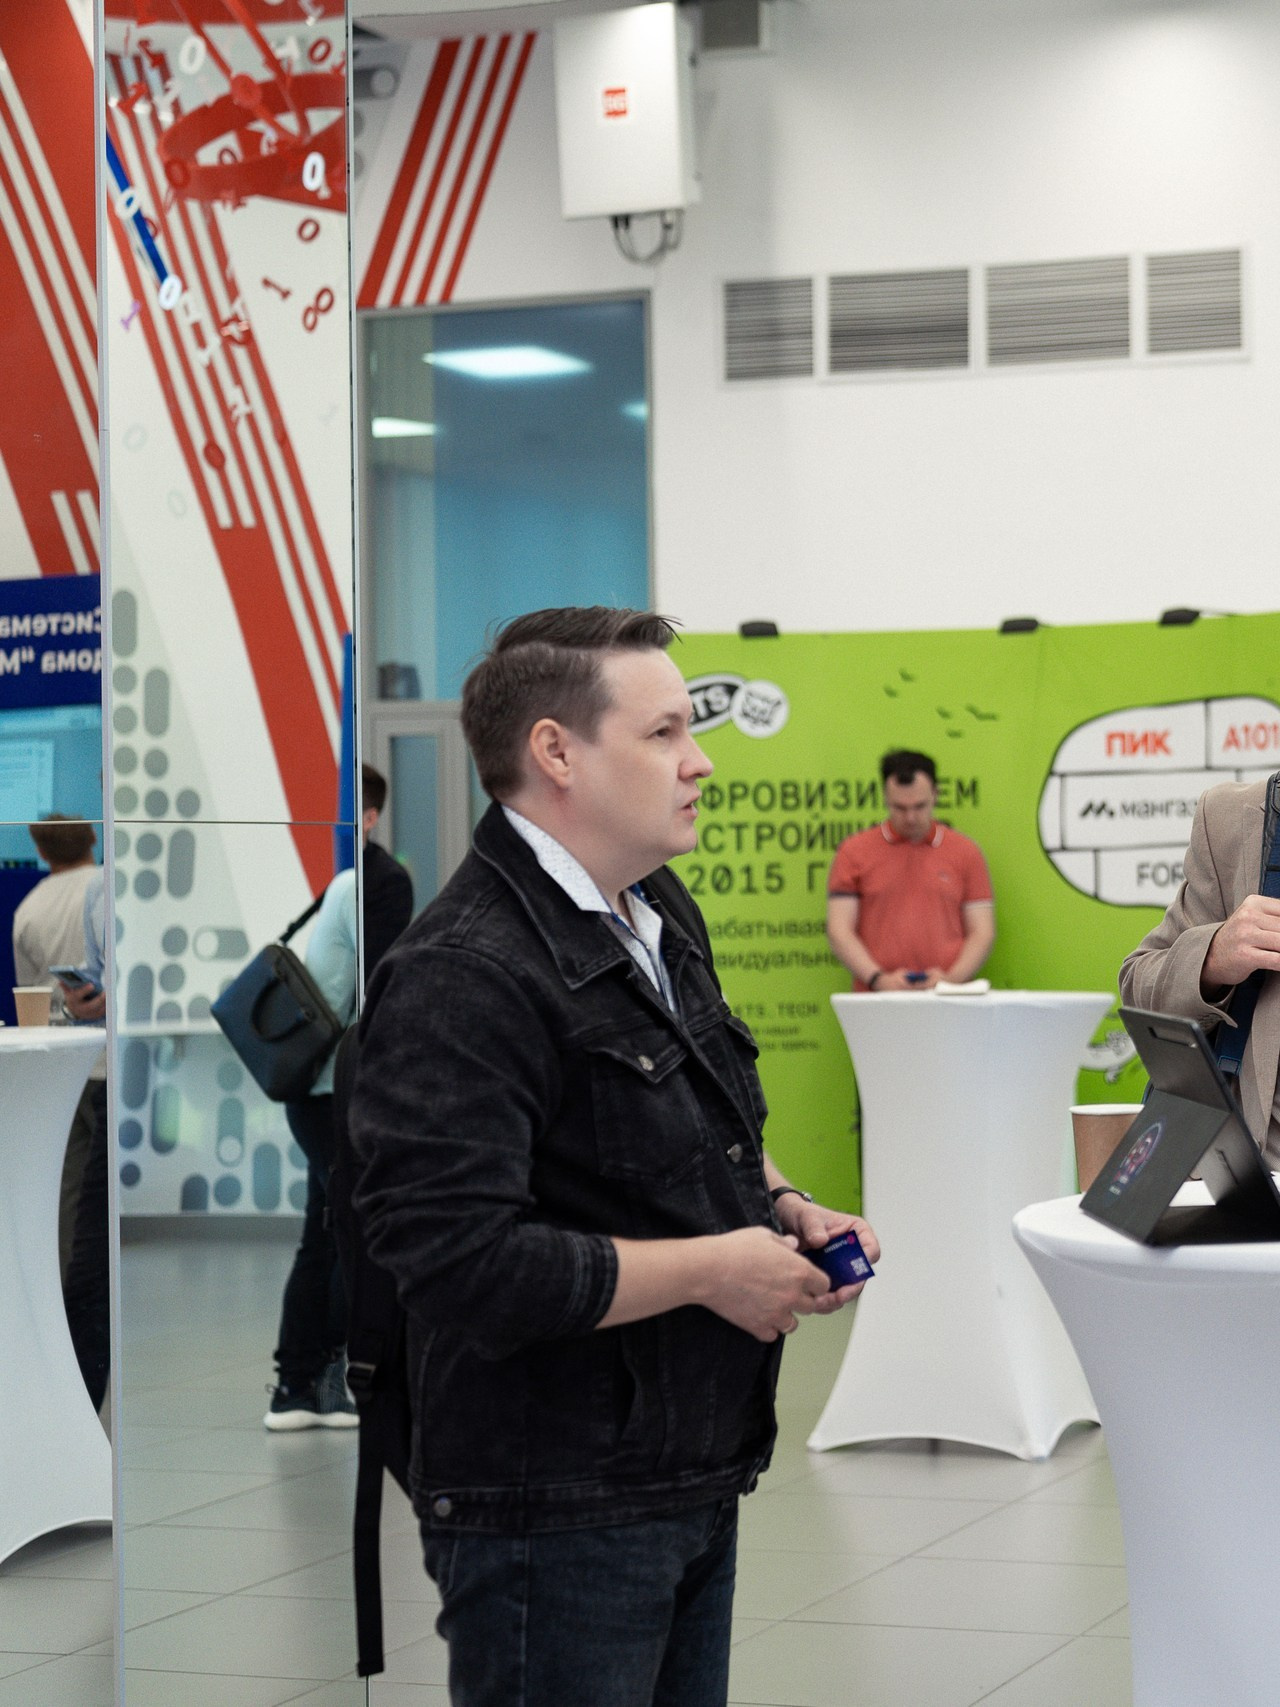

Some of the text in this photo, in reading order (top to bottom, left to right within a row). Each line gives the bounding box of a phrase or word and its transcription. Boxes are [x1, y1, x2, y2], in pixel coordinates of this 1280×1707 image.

[690, 684, 731, 725] TS
[1105, 730, 1171, 757] ПИК
[1222, 723, 1280, 751] А101
[687, 861, 785, 896] 2015
